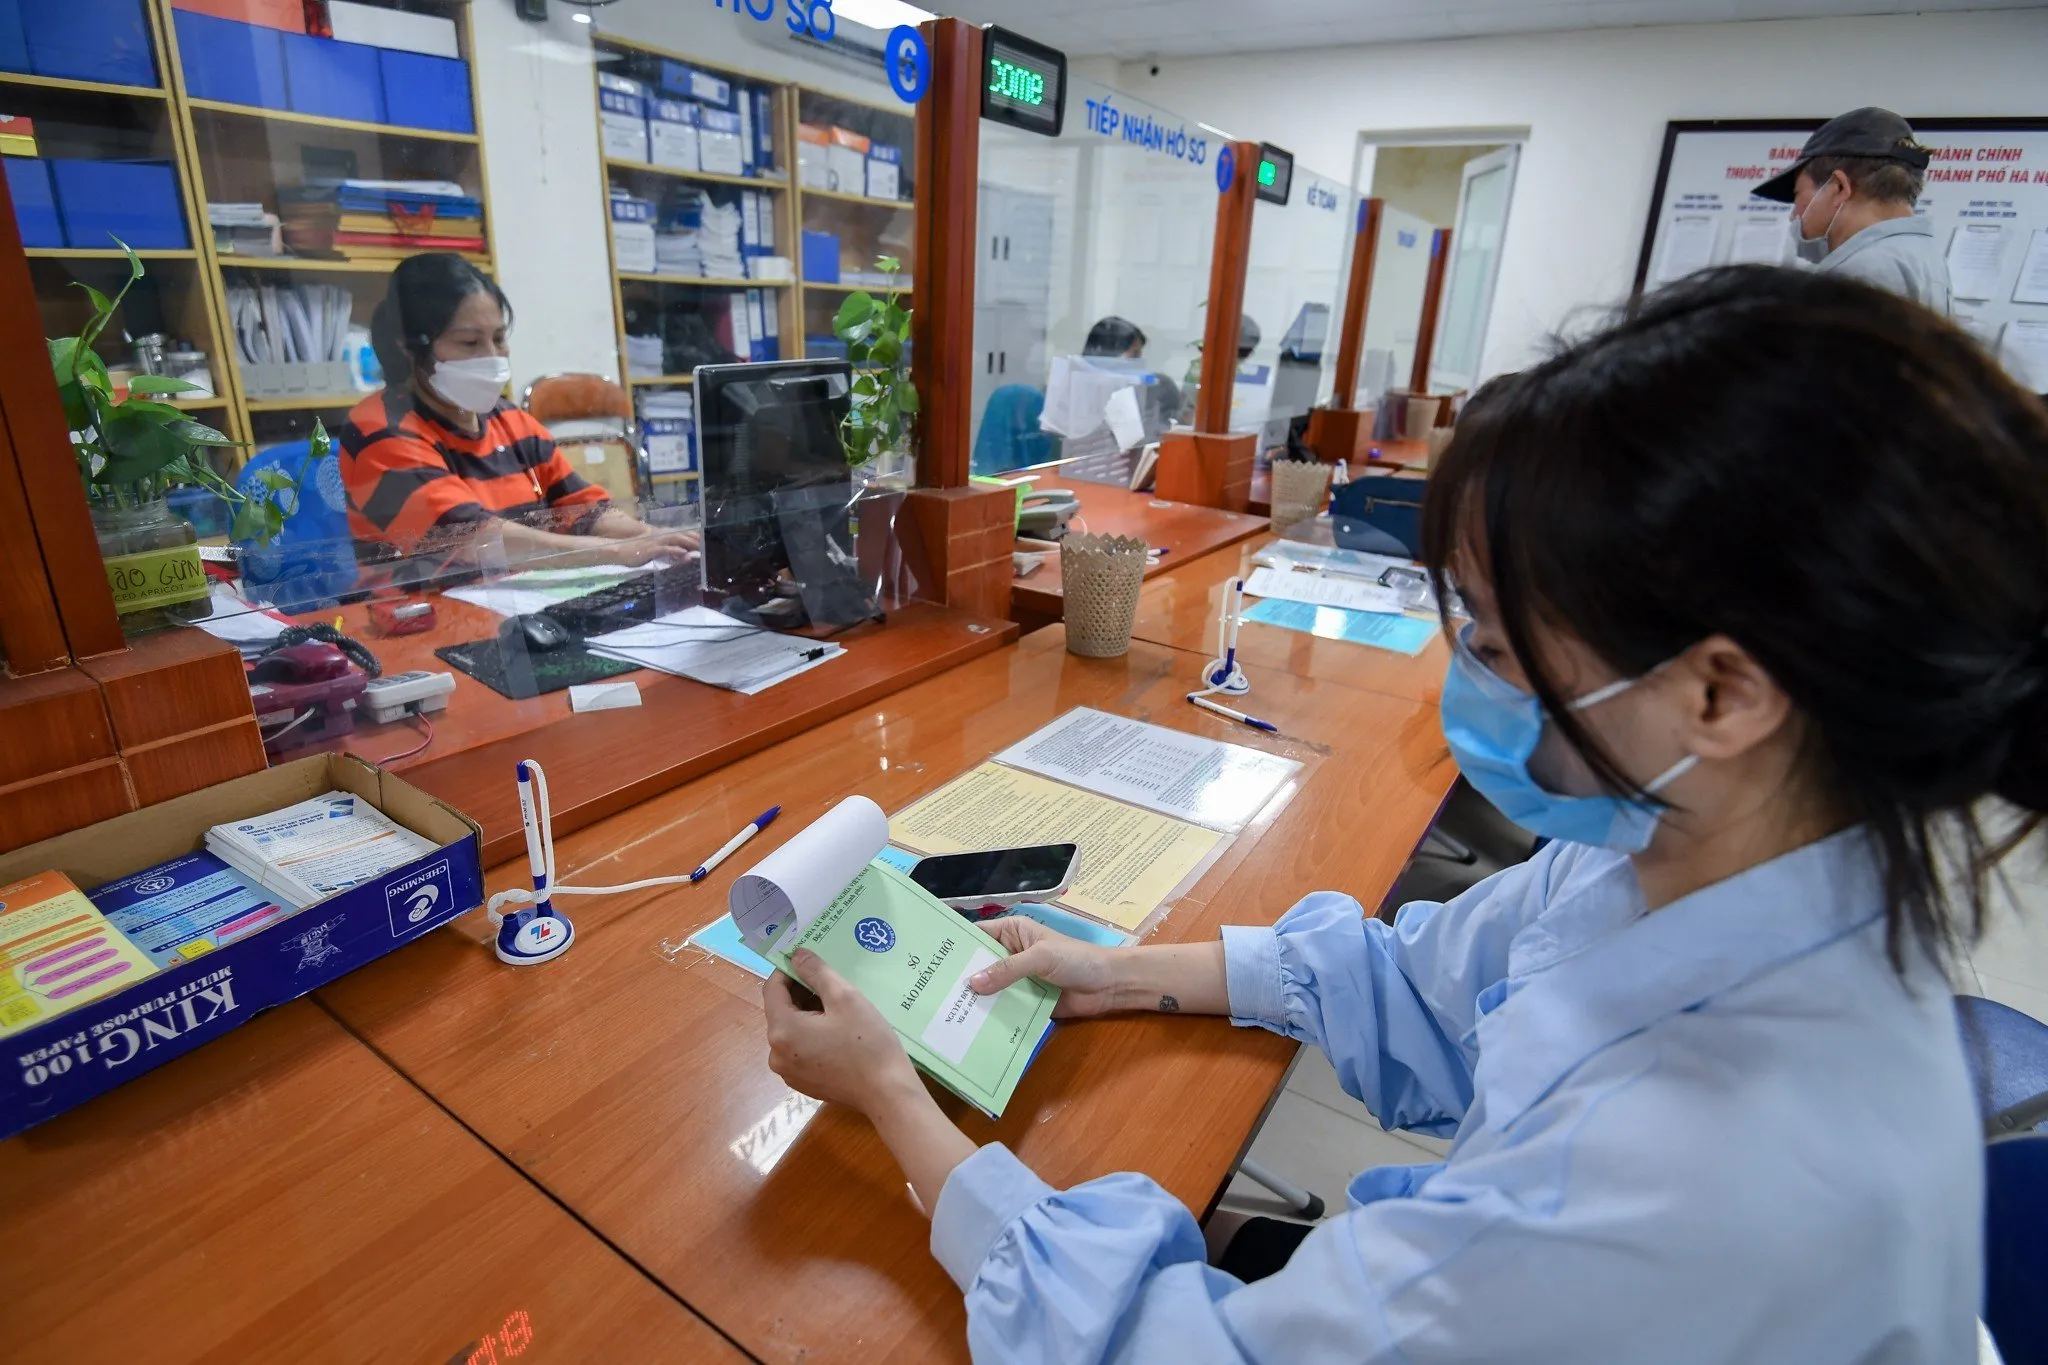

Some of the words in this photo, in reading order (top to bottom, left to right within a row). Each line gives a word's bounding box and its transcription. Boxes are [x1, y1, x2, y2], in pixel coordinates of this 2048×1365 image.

[1086, 95, 1119, 137] TIẾP
[1122, 115, 1162, 155] NHẬN
[1166, 125, 1187, 159] HỒ
[1188, 138, 1207, 165] SƠ
[1977, 145, 2023, 161] CHÍNH
[1926, 165, 1973, 182] THÀNH
[1976, 165, 2009, 182] PHỐ
[140, 583, 185, 599] APRICOT
[389, 864, 447, 898] CHENMING
[803, 926, 815, 939] HÒA
[812, 918, 822, 928] XÃ
[819, 909, 831, 921] HỘI
[826, 898, 840, 912] CHỦ
[897, 986, 920, 1011] BẢO
[909, 962, 937, 991] HIỂM
[928, 952, 944, 968] XÃ
[936, 936, 957, 957] HỘI
[902, 951, 922, 970] SỔ
[179, 965, 233, 997] MULTI
[90, 990, 178, 1037] PURPOSE
[99, 977, 240, 1070] KING
[19, 1031, 88, 1067] PAPER
[23, 1043, 93, 1086] 100
